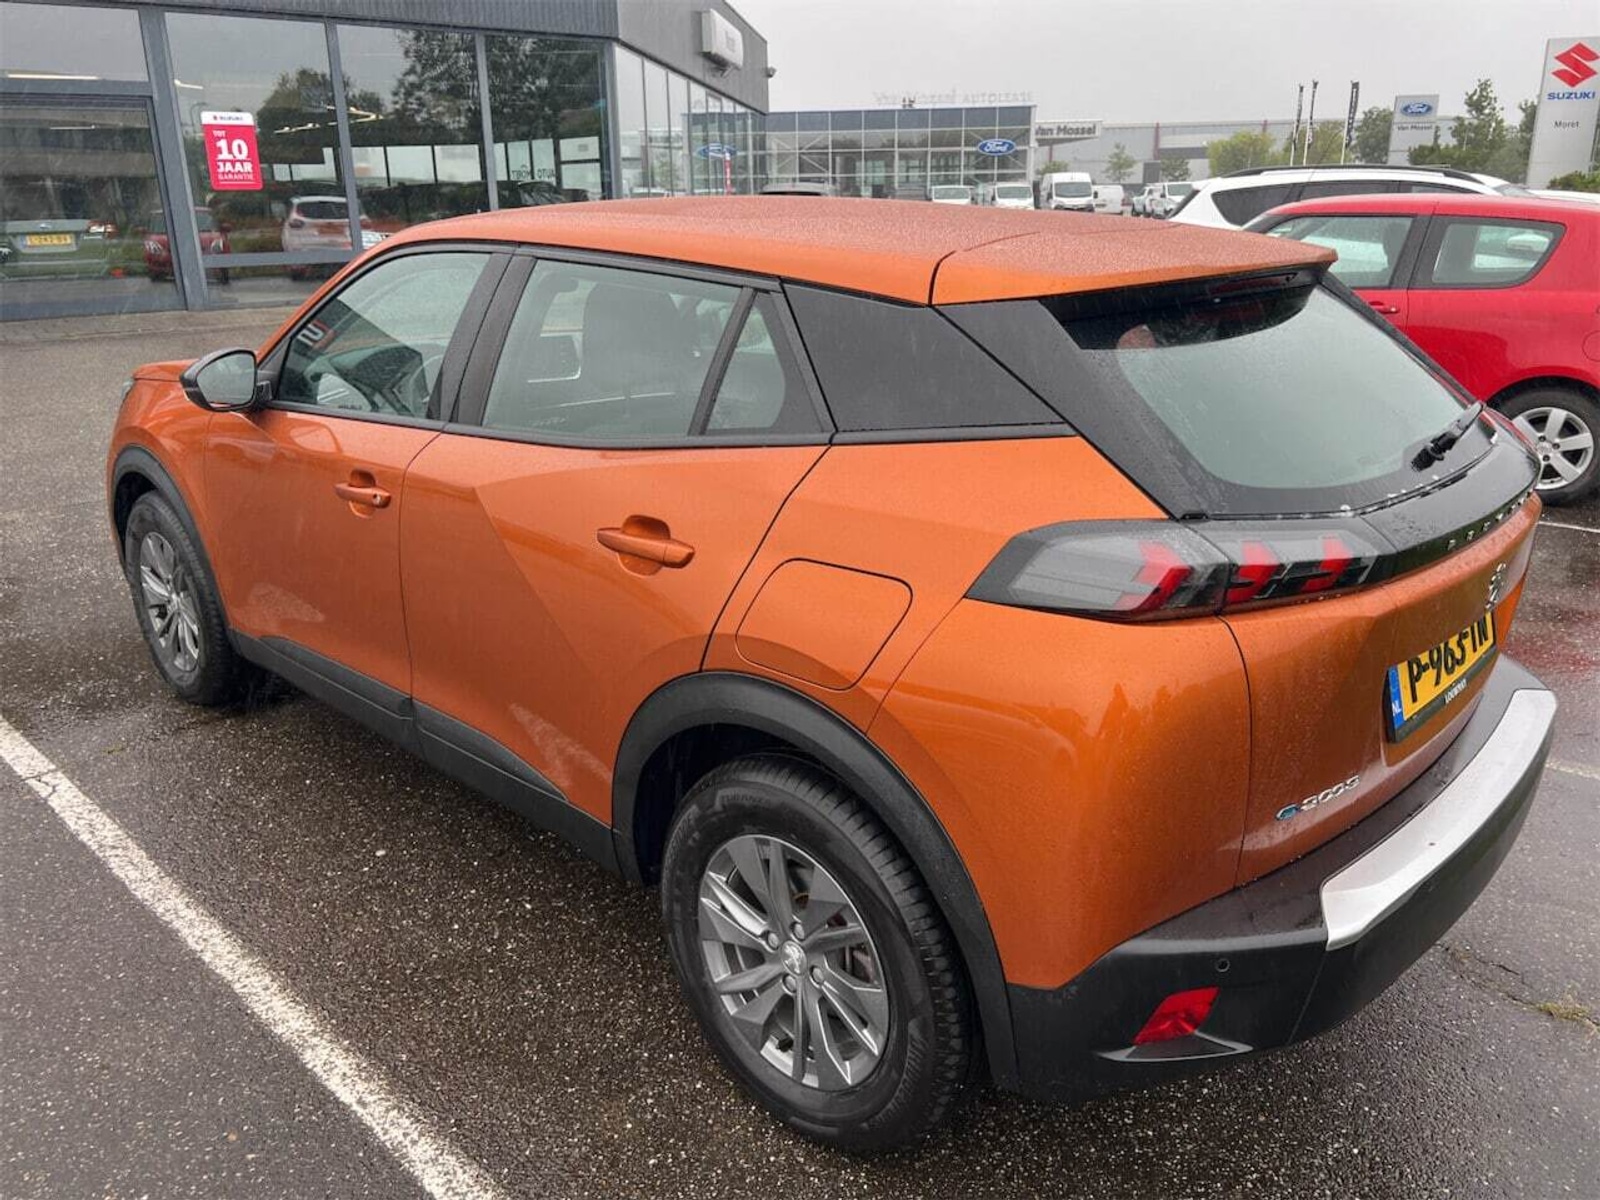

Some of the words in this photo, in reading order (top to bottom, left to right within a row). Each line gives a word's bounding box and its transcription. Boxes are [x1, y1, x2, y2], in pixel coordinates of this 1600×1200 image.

[1547, 91, 1596, 100] SUZUKI
[1056, 123, 1096, 136] Mossel
[1553, 121, 1579, 129] Moret
[215, 138, 249, 160] 10
[216, 161, 254, 173] JAAR
